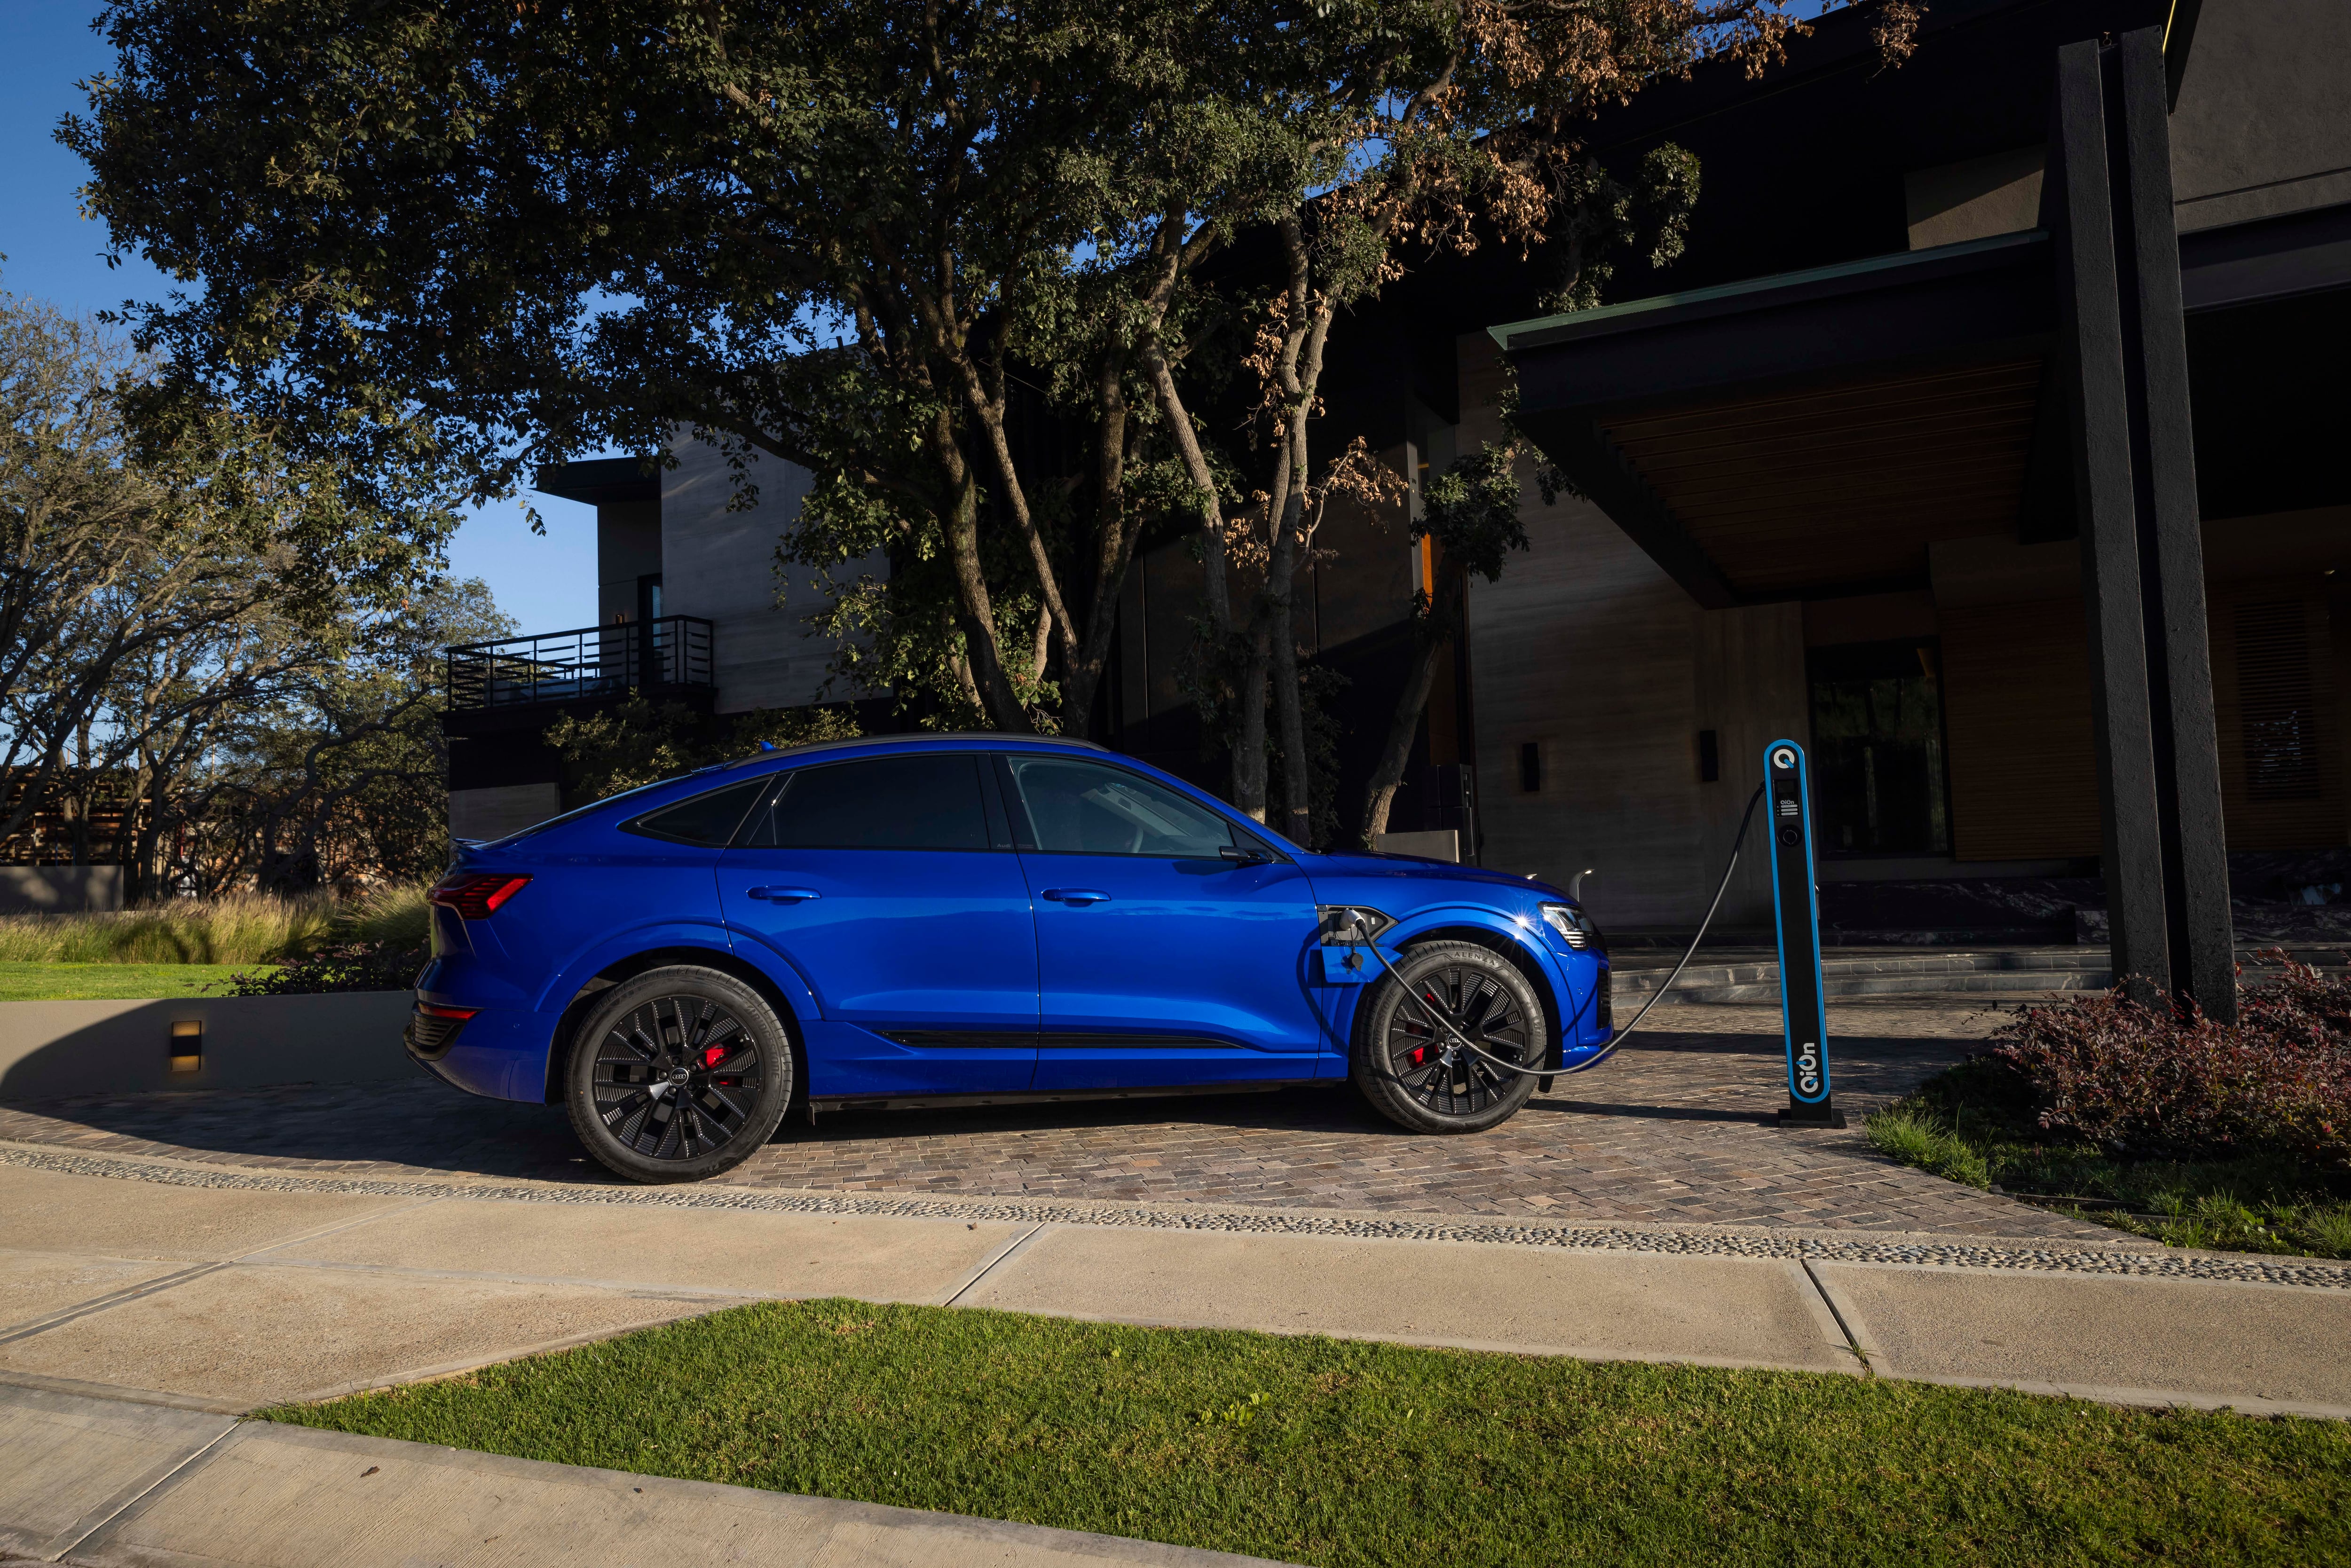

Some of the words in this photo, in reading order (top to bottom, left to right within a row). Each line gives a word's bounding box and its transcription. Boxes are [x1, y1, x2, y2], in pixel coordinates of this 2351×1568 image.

[1454, 951, 1495, 966] ALENZA
[743, 1004, 780, 1079] BRIDGESTONE
[1796, 1042, 1819, 1093] QiOn
